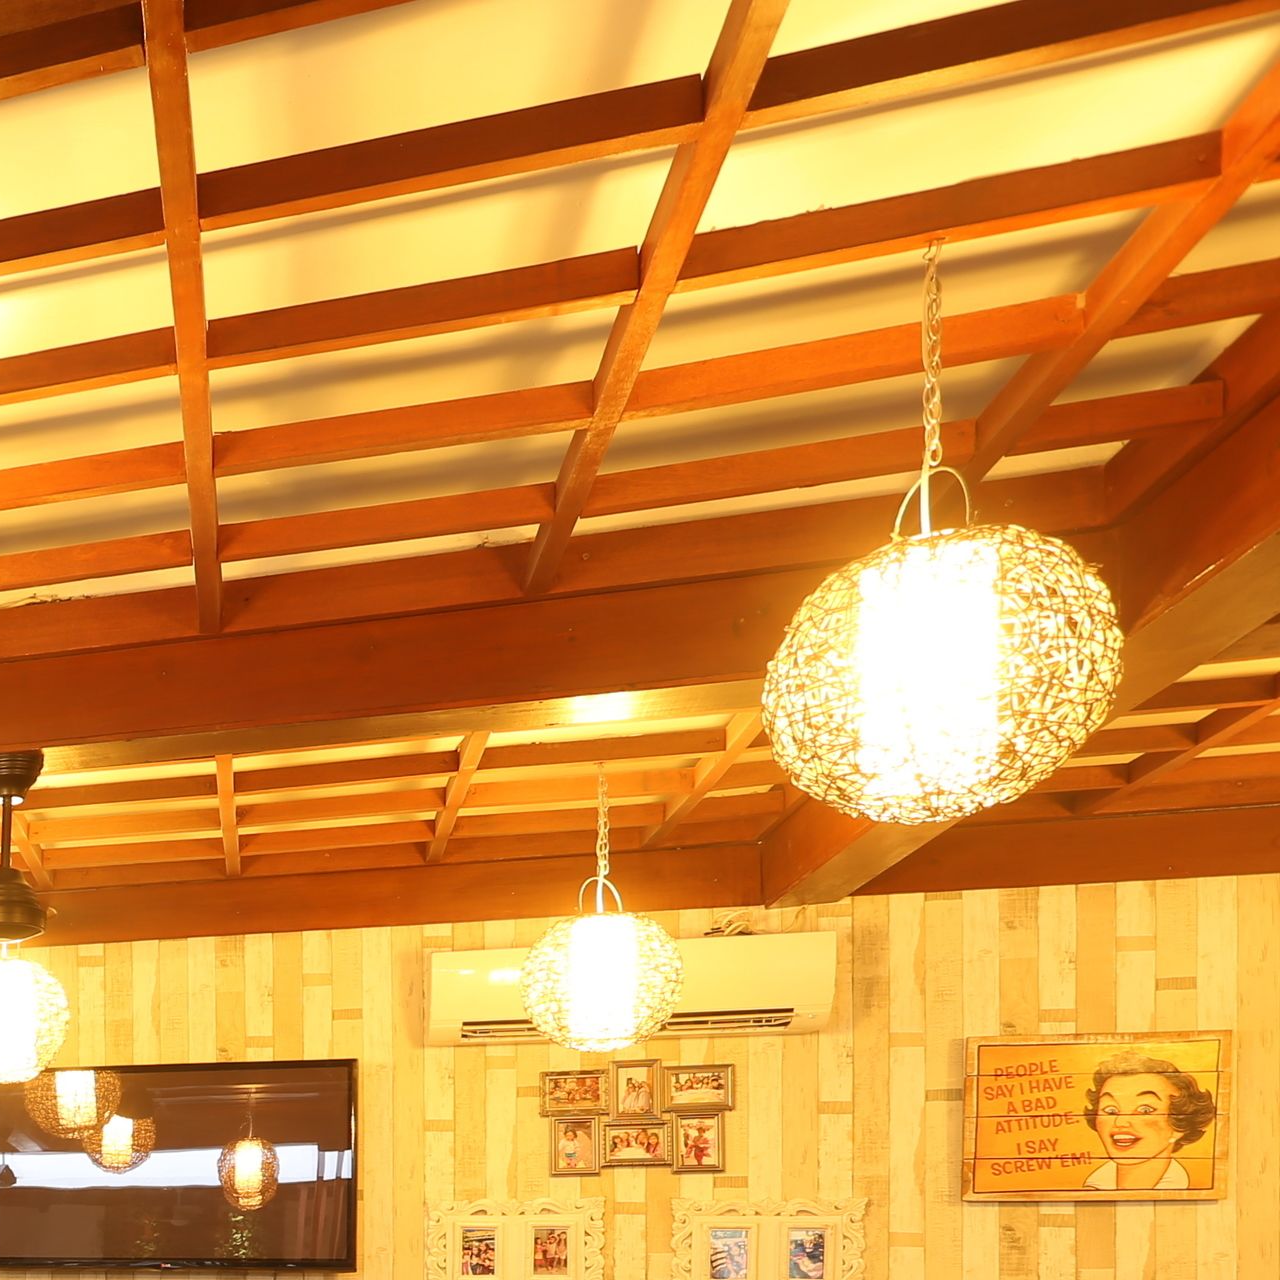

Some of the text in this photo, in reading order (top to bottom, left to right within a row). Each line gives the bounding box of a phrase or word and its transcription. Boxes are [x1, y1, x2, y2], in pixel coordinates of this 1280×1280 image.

[994, 1059, 1059, 1081] PEOPLE
[983, 1075, 1075, 1101] SAY I HAVE
[1007, 1096, 1057, 1115] A BAD
[995, 1111, 1080, 1135] ATTITUDE.
[1016, 1138, 1058, 1155] I SAY
[991, 1156, 1052, 1176] SCREW
